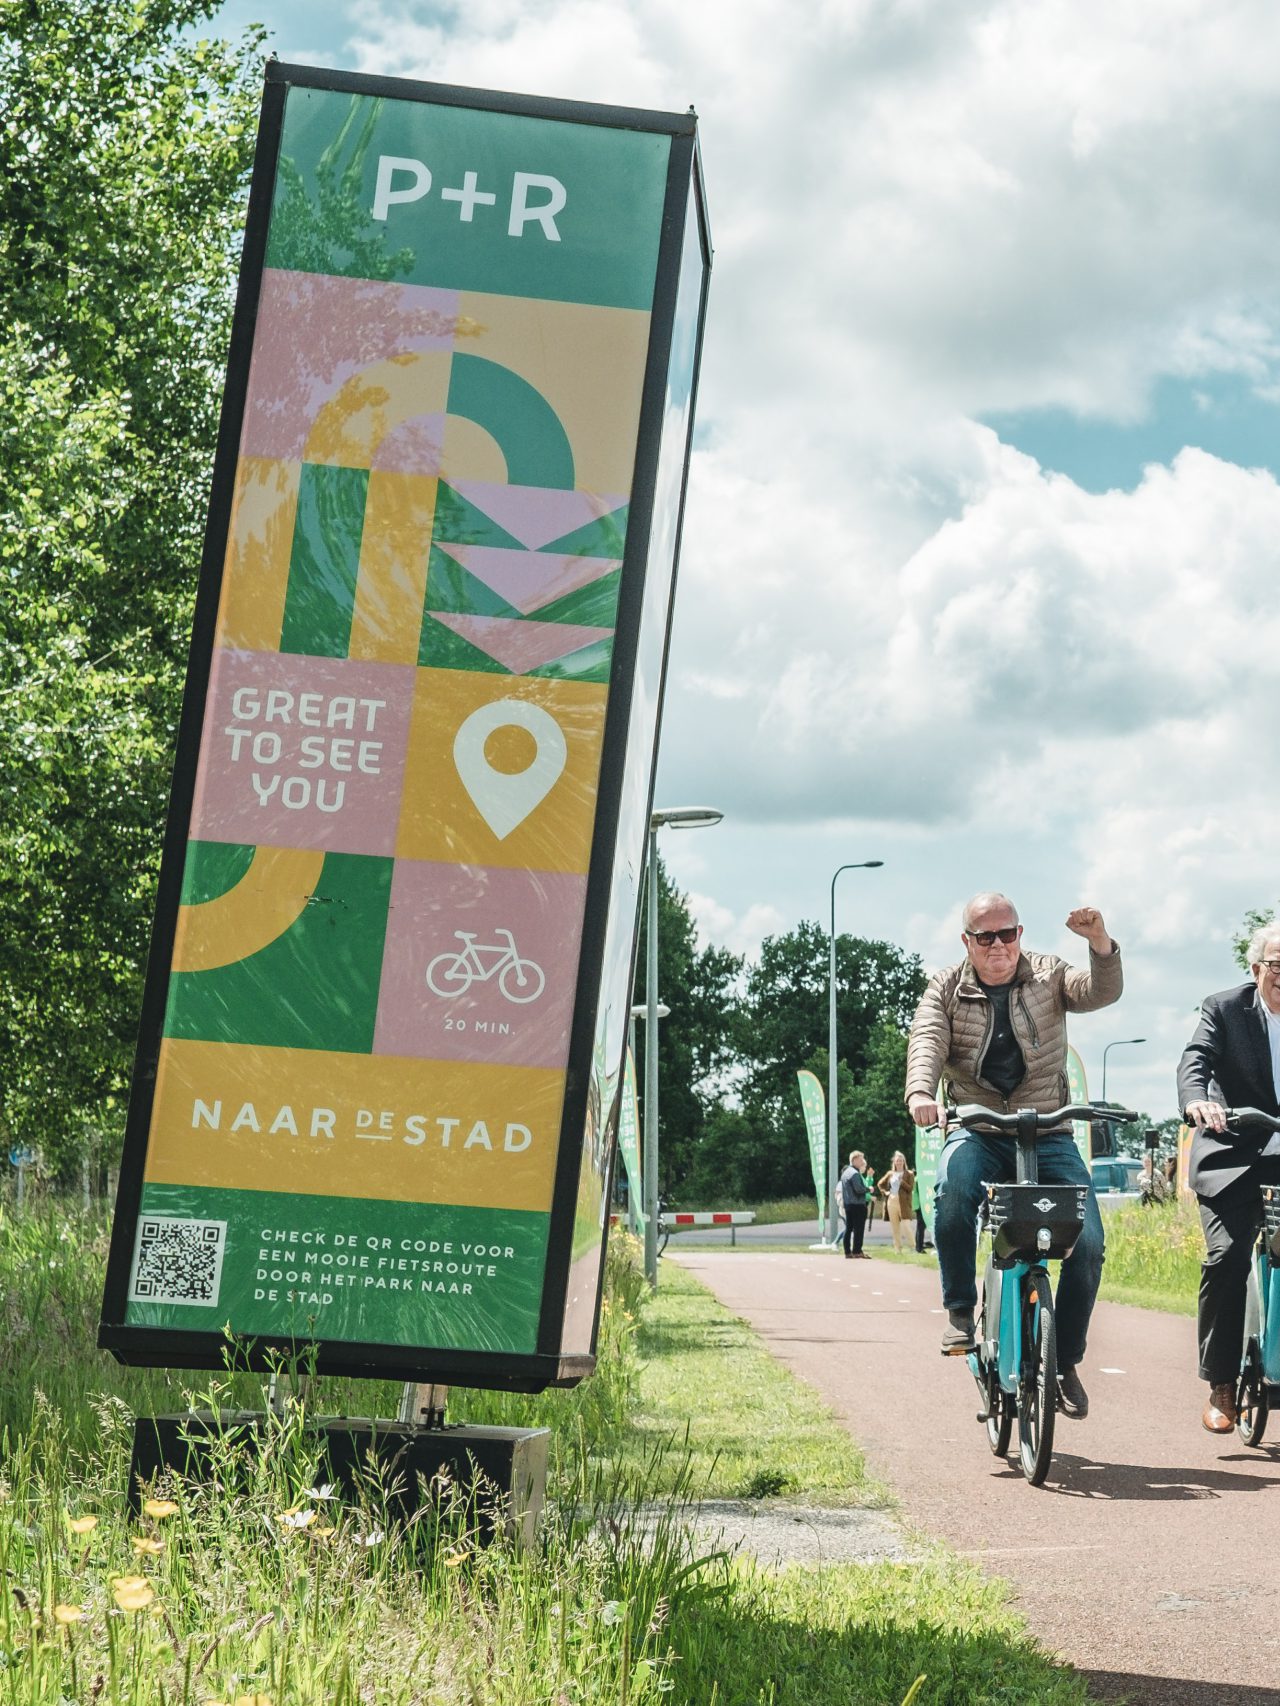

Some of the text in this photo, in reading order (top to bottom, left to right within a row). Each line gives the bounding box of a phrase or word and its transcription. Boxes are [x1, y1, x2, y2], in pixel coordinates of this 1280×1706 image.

[373, 155, 567, 241] P+R
[232, 687, 386, 731] GREAT
[225, 727, 383, 774] TO SEE
[252, 773, 345, 813] YOU
[444, 1018, 516, 1035] 20 MIN.
[191, 1099, 532, 1153] NAAR DE STAD
[261, 1229, 514, 1258] CHECK DE QR CODE VOOR
[258, 1249, 497, 1277] EEN MOOIE FIETSROUTE
[254, 1288, 333, 1305] DE STAD
[256, 1269, 473, 1295] DOOR HET PARK NAAR
